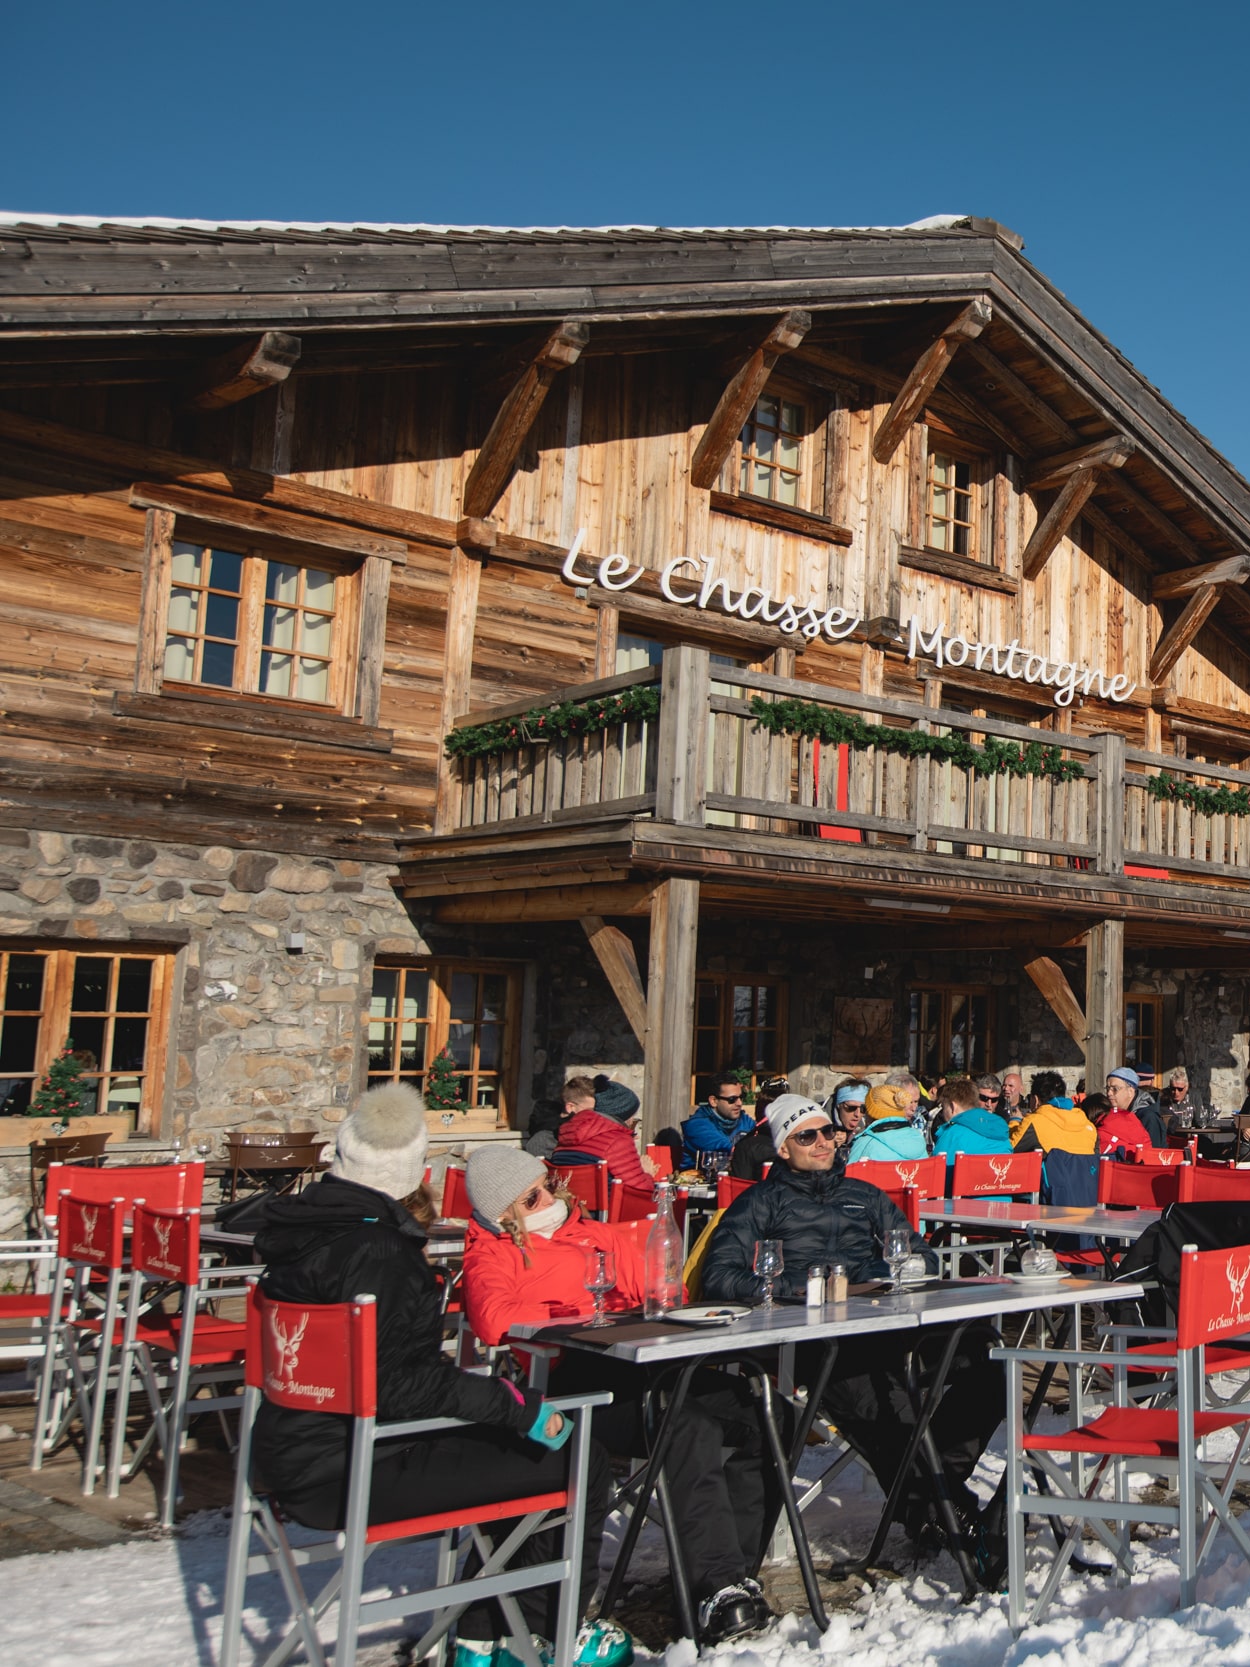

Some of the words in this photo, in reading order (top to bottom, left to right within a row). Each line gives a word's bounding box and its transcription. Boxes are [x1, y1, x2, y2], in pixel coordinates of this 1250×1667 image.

[561, 526, 645, 591] Le
[907, 613, 1138, 707] Montagne
[782, 1105, 817, 1131] PEAK
[288, 1380, 335, 1404] Montagne
